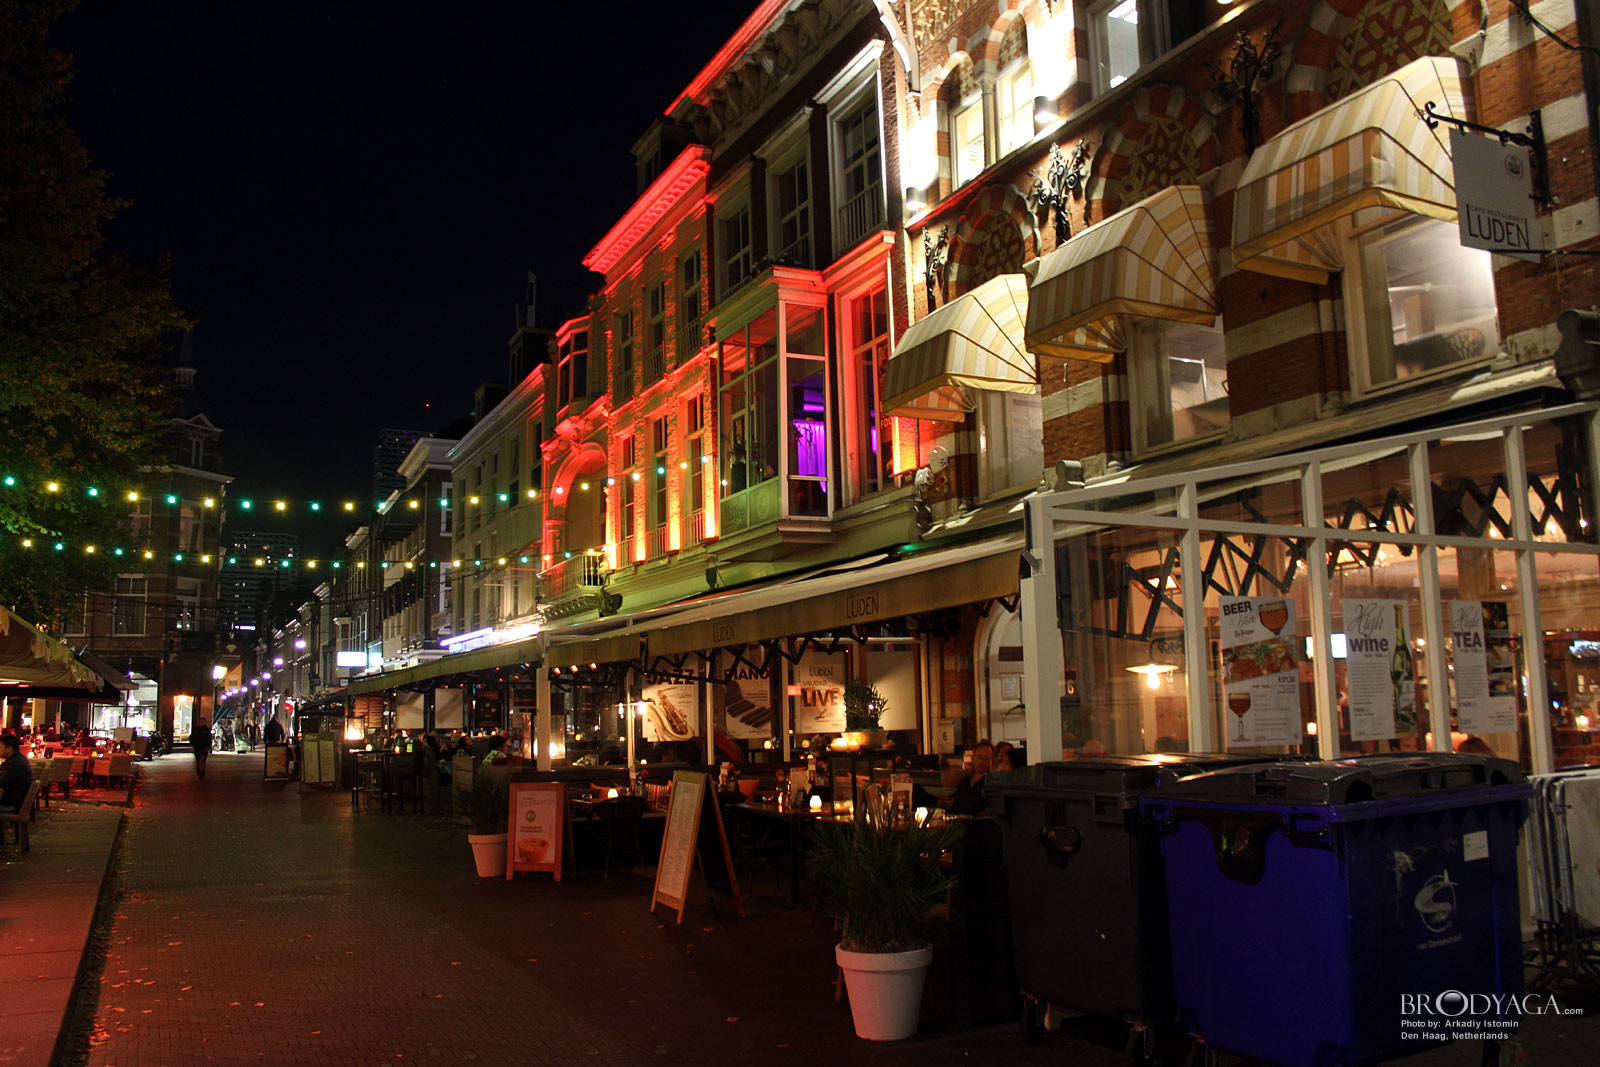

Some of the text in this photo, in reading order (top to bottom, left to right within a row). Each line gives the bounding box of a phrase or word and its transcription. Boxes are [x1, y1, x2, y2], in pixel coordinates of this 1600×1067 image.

[1466, 203, 1530, 250] LUDEN
[846, 588, 879, 619] LUDEN
[1222, 601, 1252, 616] BEER
[1349, 602, 1384, 638] High
[1349, 633, 1389, 652] wine
[1453, 632, 1483, 649] TEA
[645, 669, 695, 685] JAZZ
[724, 668, 770, 680] PIANO
[809, 666, 833, 677] LUDEN
[801, 688, 839, 707] LIVE
[942, 731, 948, 741] 6
